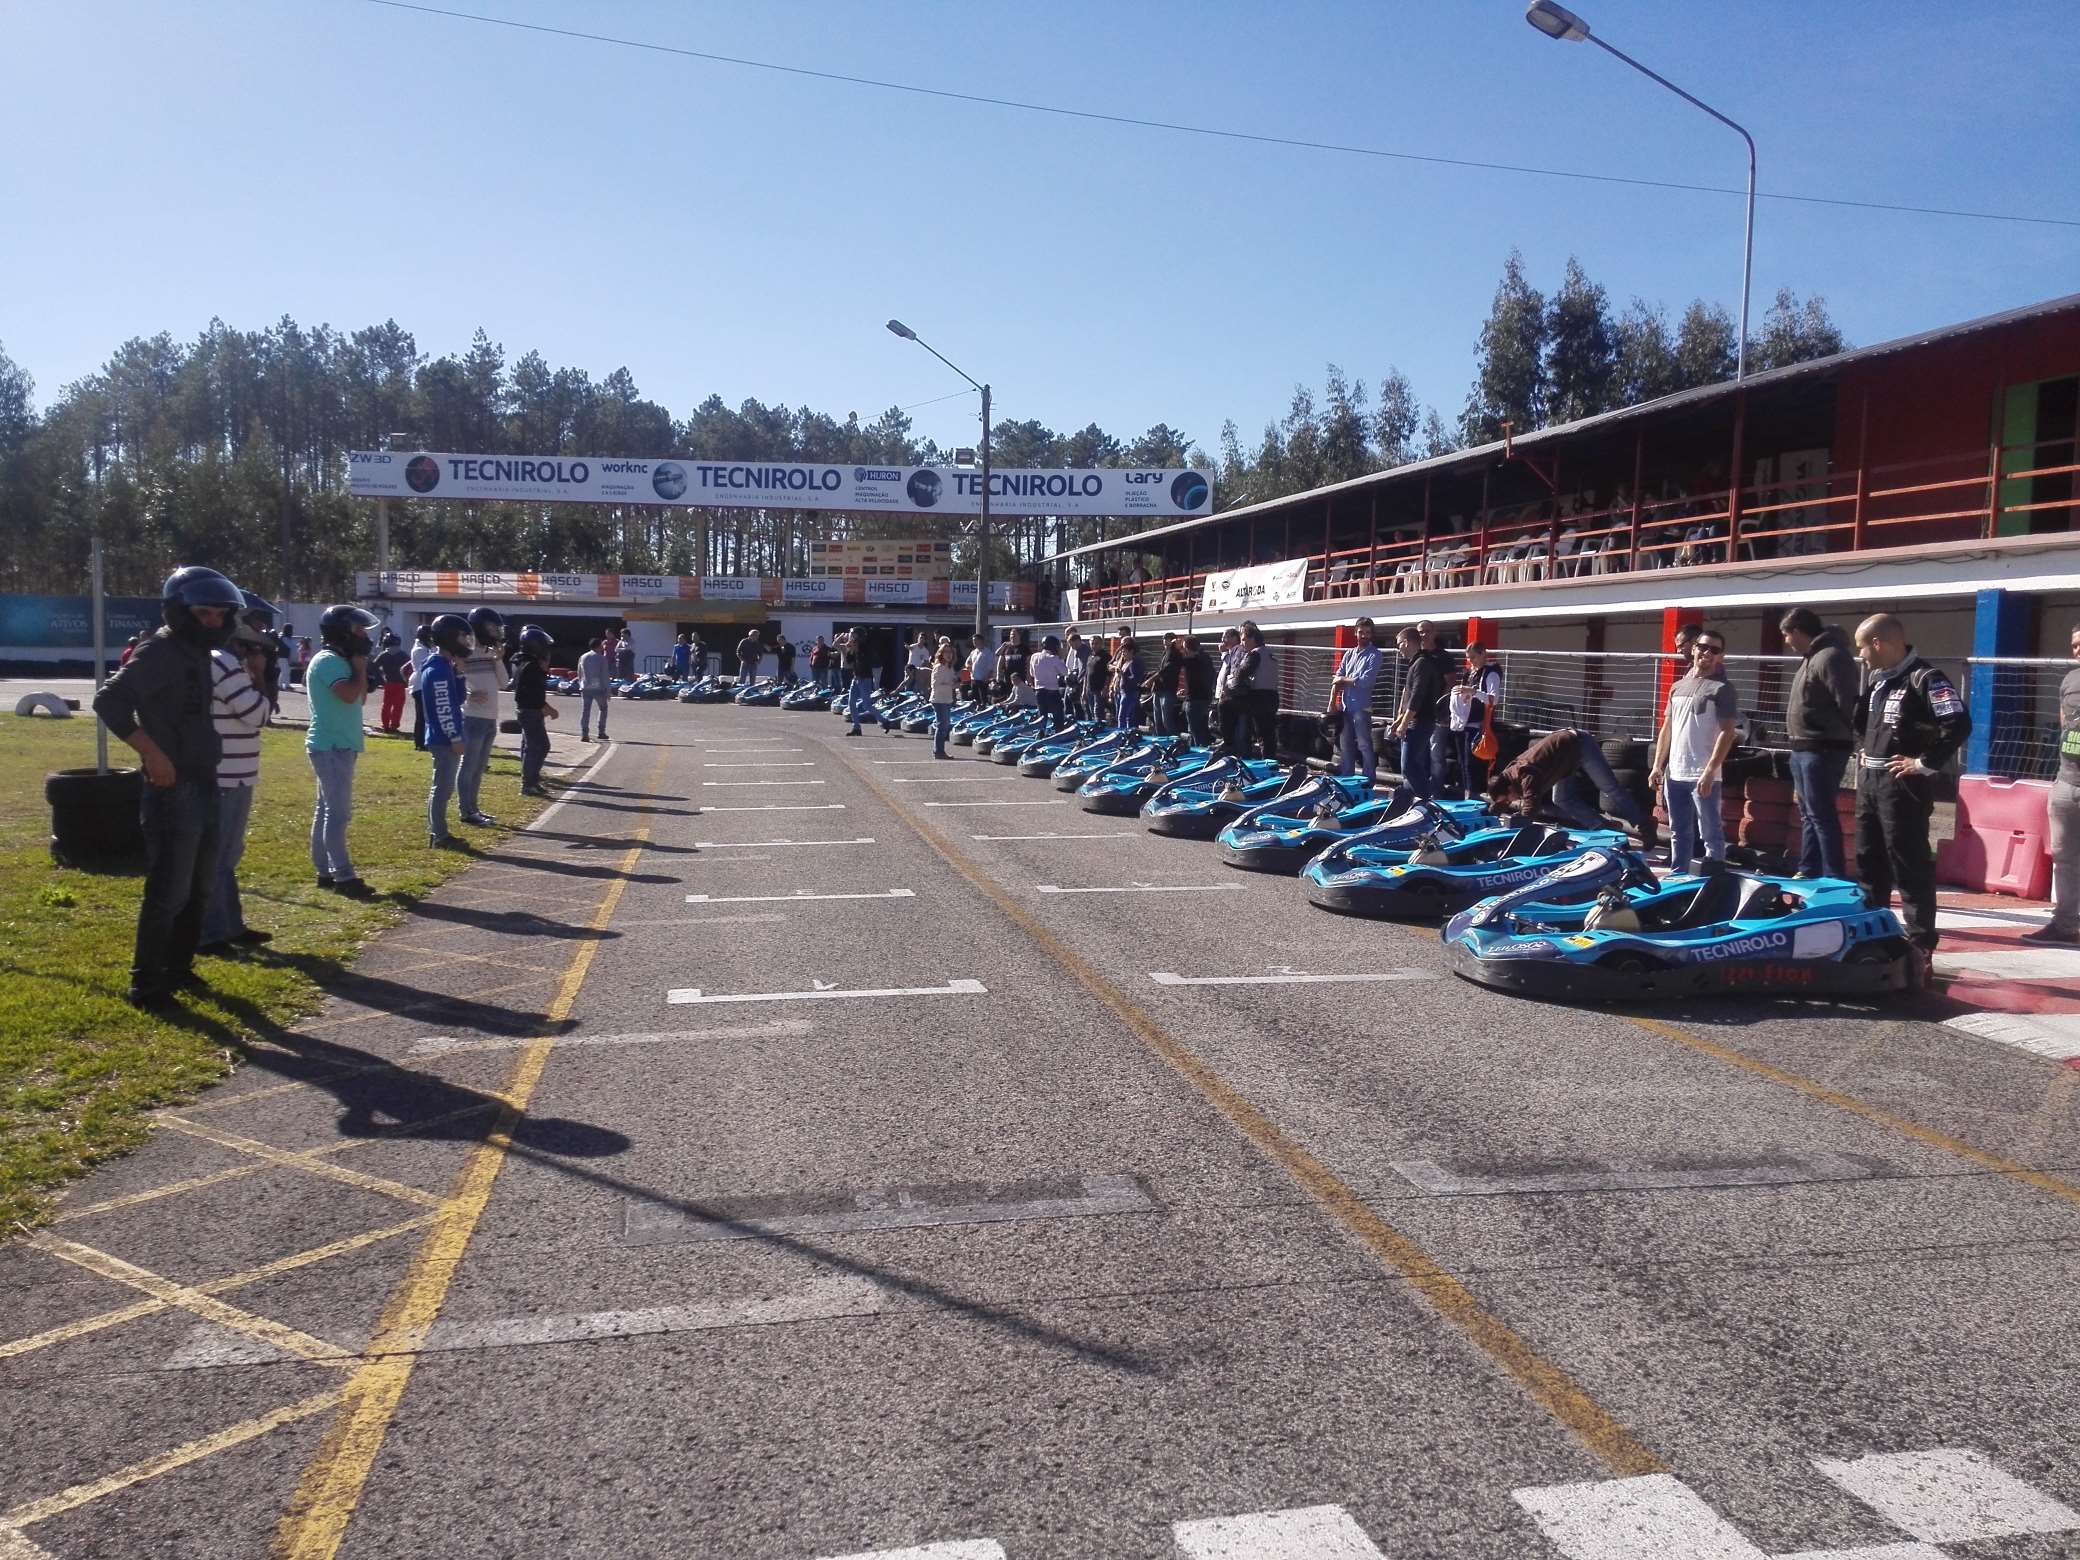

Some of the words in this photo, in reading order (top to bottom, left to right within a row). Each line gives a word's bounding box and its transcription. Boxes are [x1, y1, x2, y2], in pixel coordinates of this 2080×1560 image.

[448, 459, 590, 483] TECNIROLO
[601, 461, 648, 474] worknc
[697, 466, 842, 491] TECNIROLO
[869, 471, 899, 480] HURON
[952, 473, 1103, 497] TECNIROLO
[382, 573, 421, 583] HASCO
[461, 574, 500, 584] HASCO
[542, 576, 581, 586] HASCO
[623, 578, 662, 588] HASCO
[704, 580, 744, 590] HASCO
[786, 582, 826, 592] HASCO
[869, 583, 910, 593] HASCO
[953, 584, 994, 594] HASO
[1476, 866, 1550, 888] TECNIROLO
[1691, 932, 1787, 962] TECNIROLO
